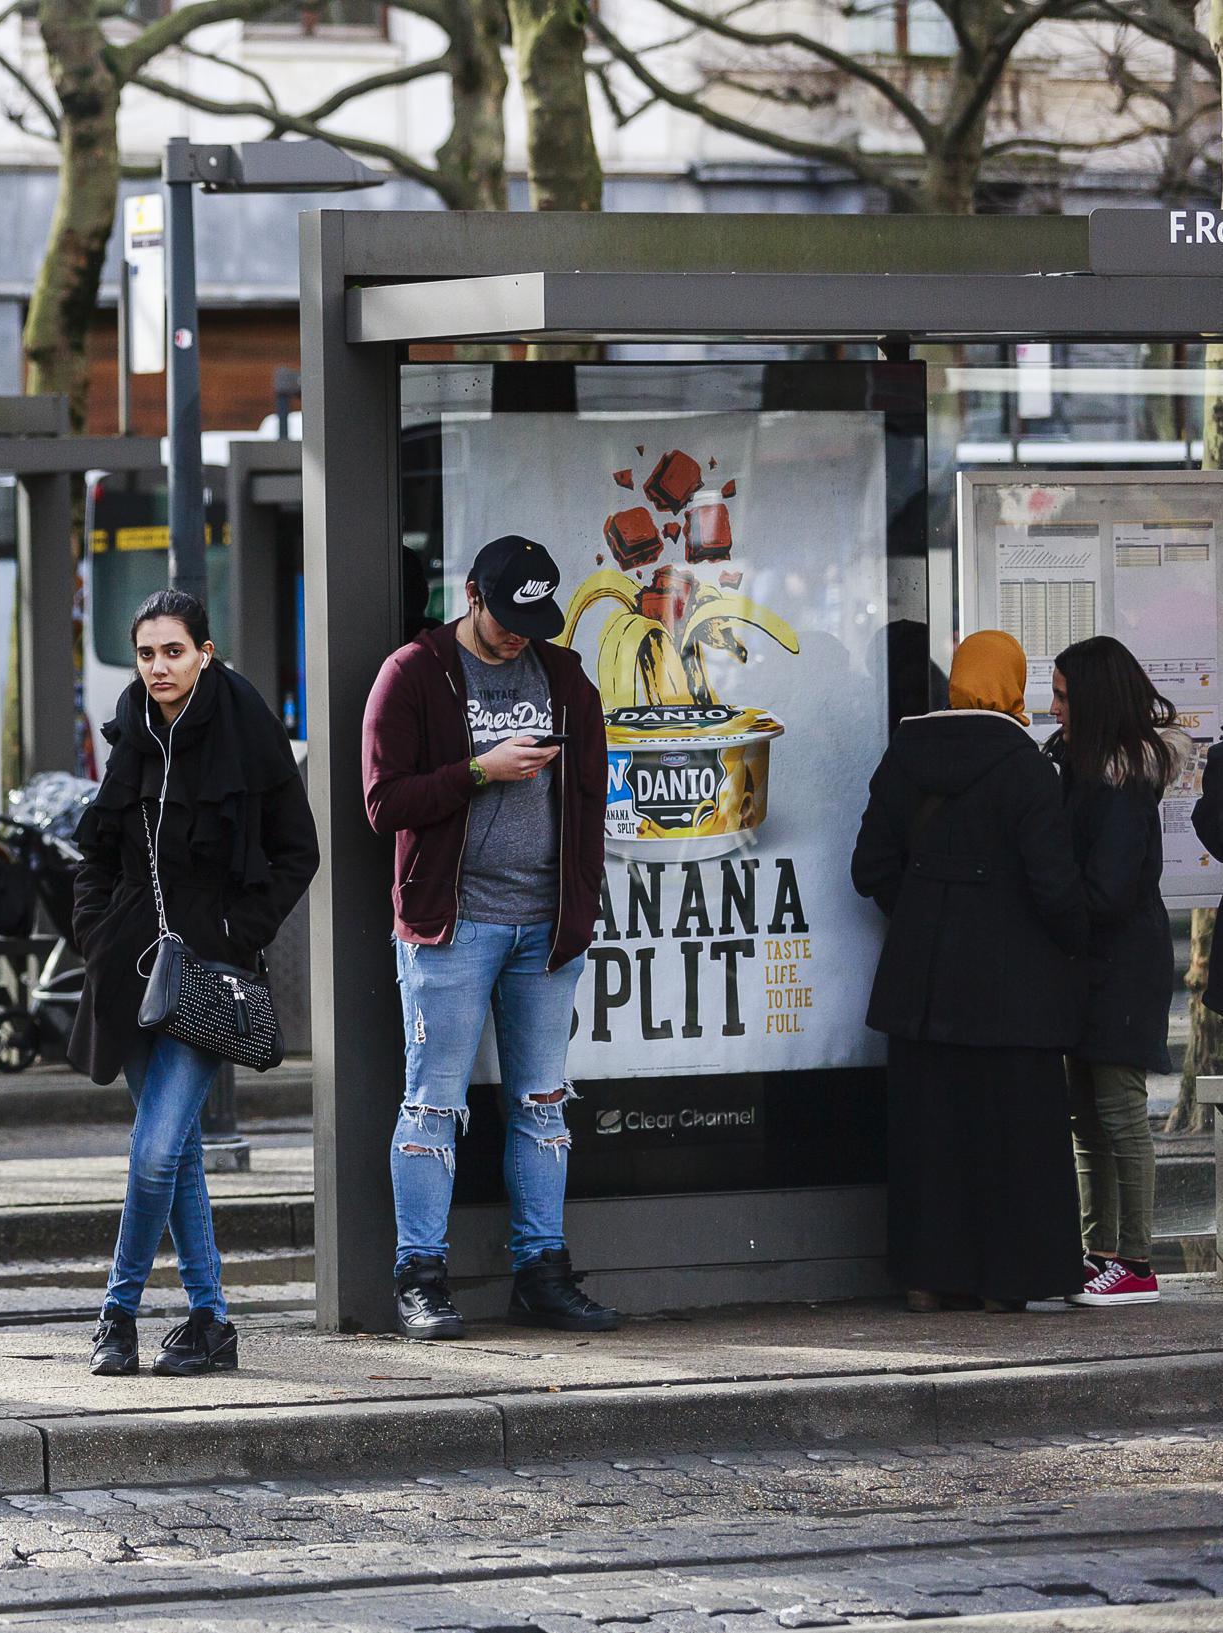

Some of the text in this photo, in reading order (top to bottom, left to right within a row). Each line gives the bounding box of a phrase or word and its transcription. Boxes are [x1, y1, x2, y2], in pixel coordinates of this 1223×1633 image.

[1170, 211, 1223, 244] F.R
[521, 579, 550, 596] NIKE
[617, 709, 728, 722] DANIO
[637, 767, 716, 802] DANIO
[607, 809, 630, 821] ANANA
[617, 822, 635, 835] SPLIT
[592, 858, 809, 941] ANANA
[764, 938, 812, 960] TASTE
[765, 964, 801, 985] LIFE.
[570, 938, 756, 1043] PLIT
[766, 987, 813, 1009] TO THE
[766, 1014, 805, 1034] FULL.
[625, 1105, 756, 1130] Clear Channel
